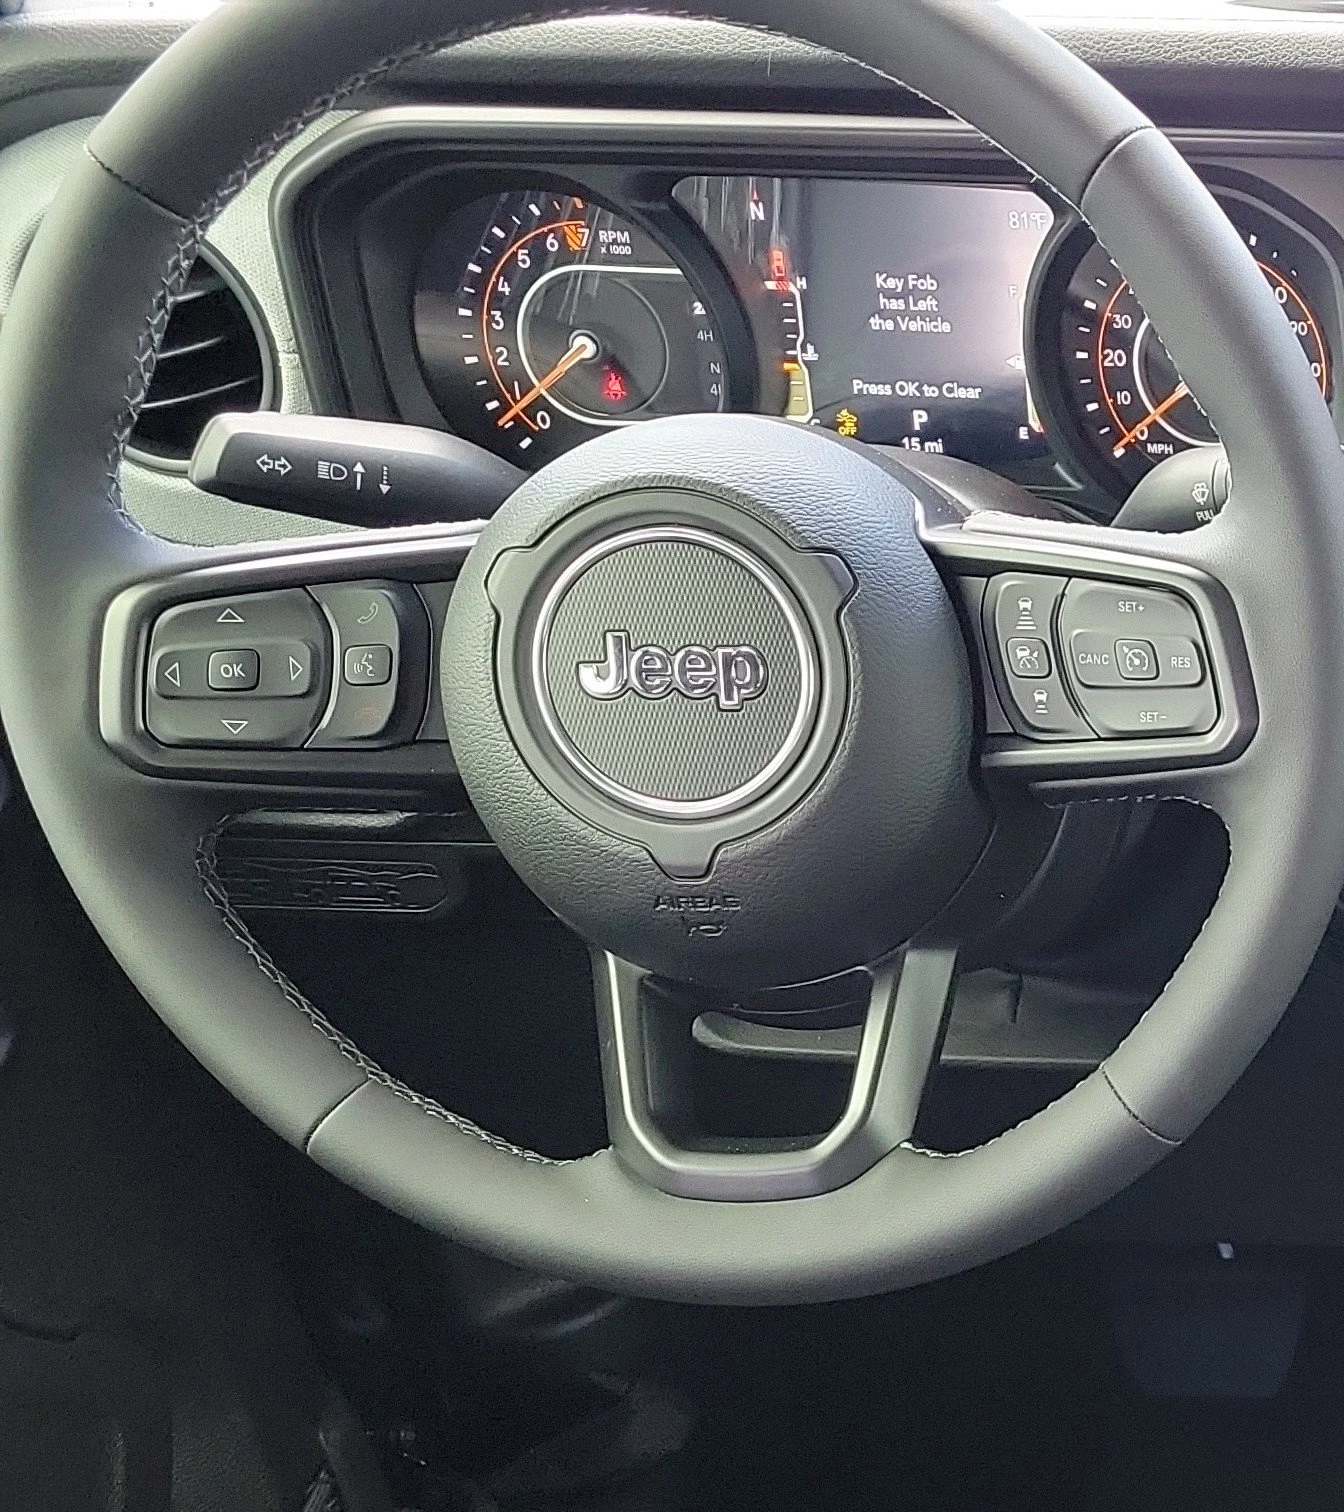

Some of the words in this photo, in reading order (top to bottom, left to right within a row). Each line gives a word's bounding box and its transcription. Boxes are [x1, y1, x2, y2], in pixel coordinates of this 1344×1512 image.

[749, 201, 765, 221] N
[546, 233, 560, 252] 6
[578, 228, 590, 248] 7
[598, 230, 631, 245] RPM
[609, 244, 632, 256] 1000
[516, 250, 531, 270] 5
[497, 277, 512, 296] 4
[796, 276, 808, 290] H
[875, 272, 904, 292] Key
[908, 273, 938, 292] Fob
[1008, 286, 1018, 298] F
[879, 292, 906, 310] has
[908, 294, 939, 312] Left
[490, 310, 505, 330] 3
[869, 315, 895, 332] the
[900, 316, 952, 334] Vehicle
[1112, 314, 1132, 330] 30
[696, 329, 714, 342] 4H
[496, 346, 510, 366] 2
[1103, 350, 1127, 367] 20
[710, 362, 721, 374] N
[513, 380, 522, 400] 1
[852, 379, 893, 397] Press
[894, 380, 922, 398] OK
[922, 383, 940, 398] to
[941, 382, 982, 400] Clear
[1116, 392, 1132, 406] 10
[536, 410, 551, 430] 0
[912, 408, 928, 431] P
[838, 426, 858, 436] OFF
[1018, 427, 1030, 440] E
[1136, 427, 1149, 440] 0
[902, 436, 922, 452] 15
[924, 438, 944, 454] mi
[1146, 442, 1174, 455] MPH
[1078, 653, 1110, 666] CANC
[1170, 656, 1192, 668] RES
[219, 662, 246, 678] OK
[577, 630, 770, 712] Jeep
